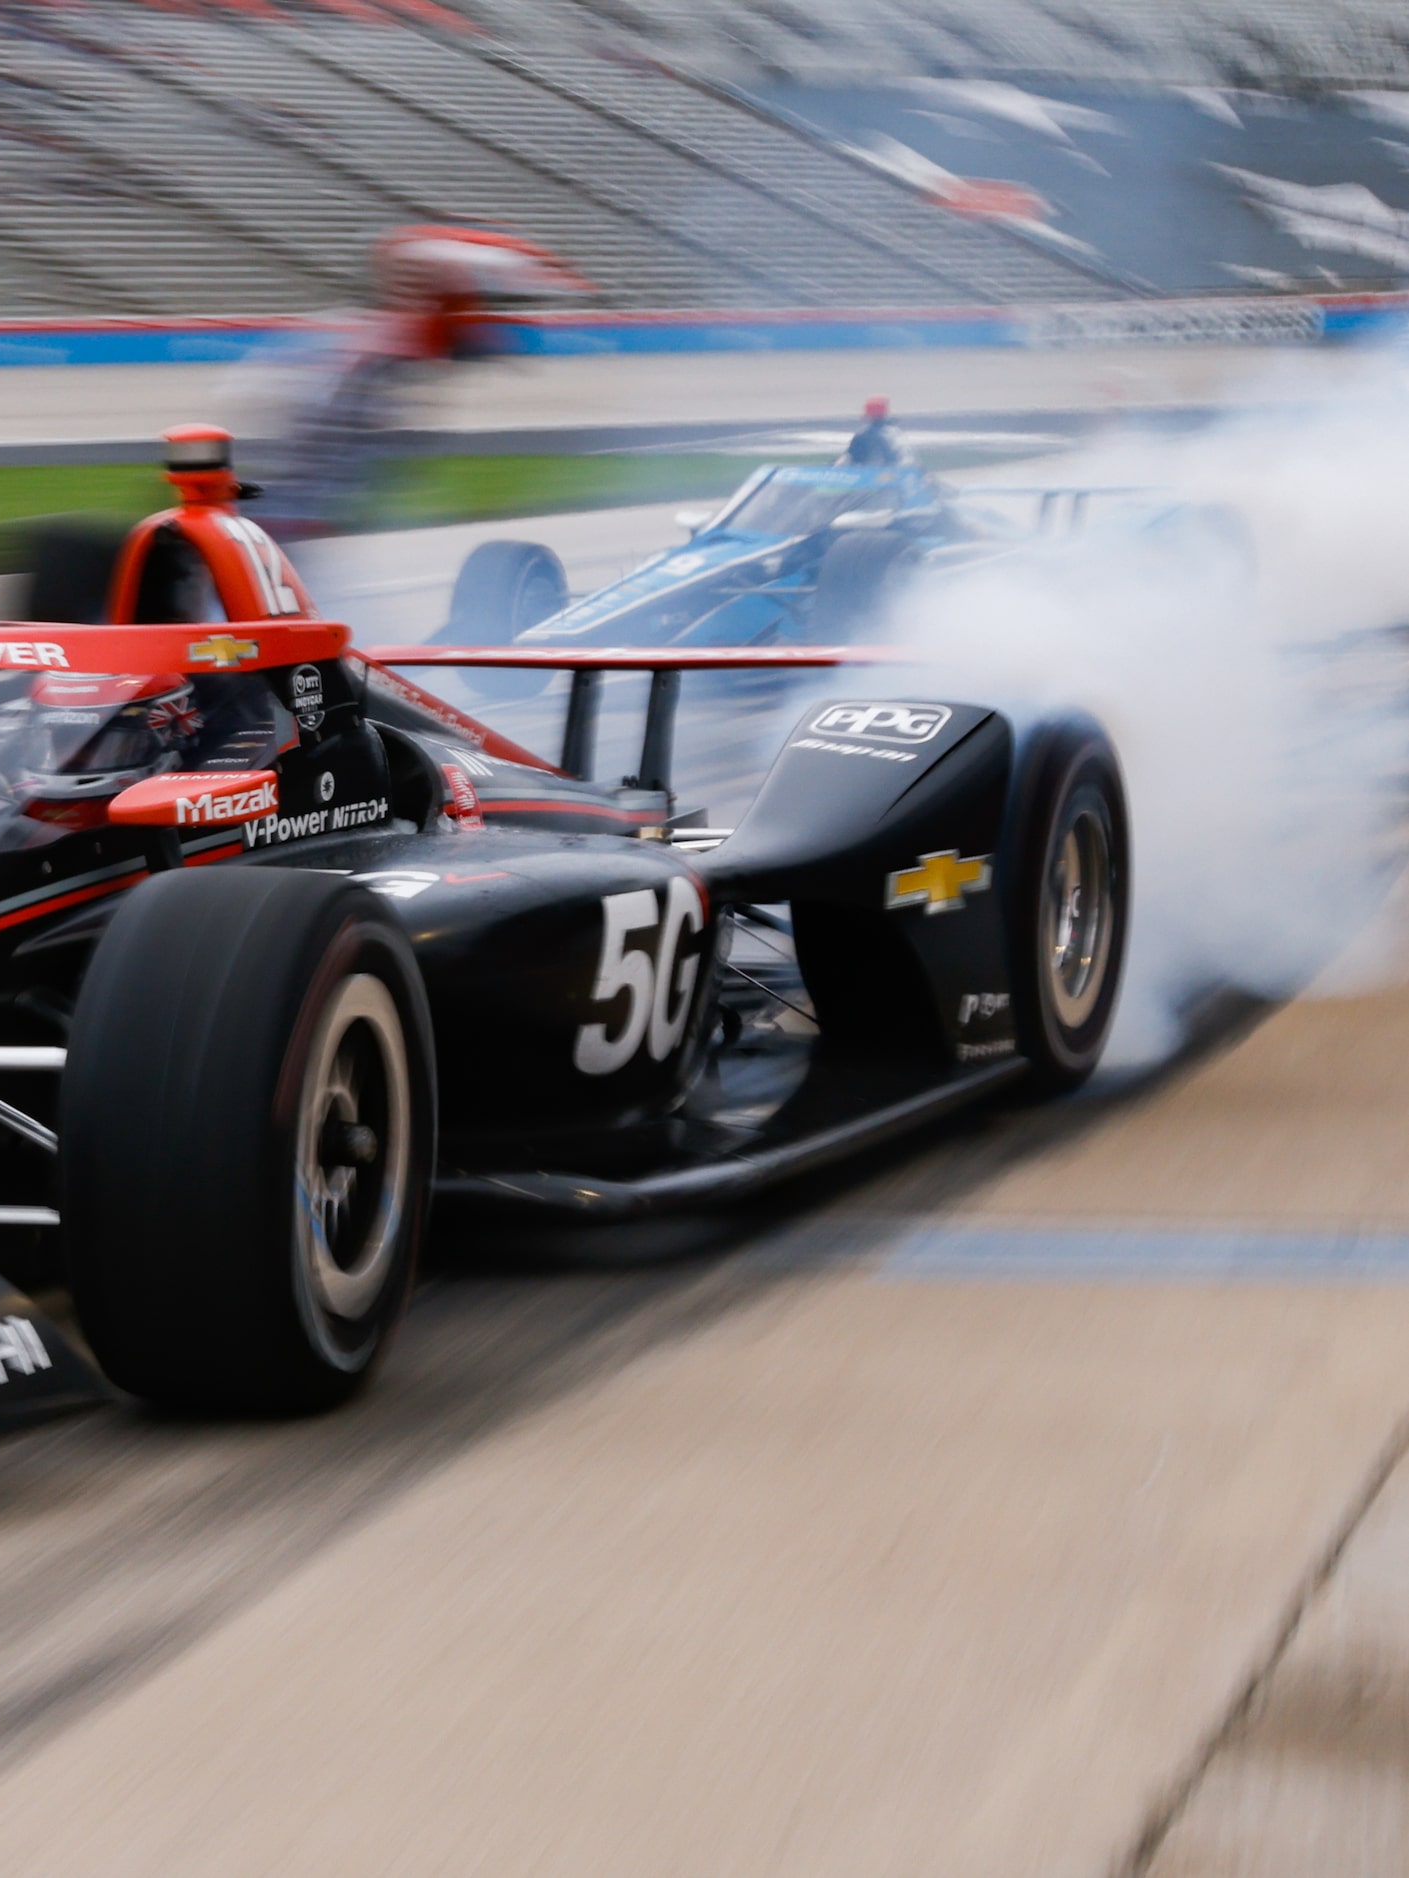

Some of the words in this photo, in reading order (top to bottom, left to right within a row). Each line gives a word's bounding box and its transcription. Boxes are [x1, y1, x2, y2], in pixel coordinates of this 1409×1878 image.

[214, 515, 301, 617] 12
[295, 694, 324, 708] INDYCAR
[818, 706, 941, 736] PPG
[159, 773, 252, 781] SIEMENS
[176, 781, 279, 824] Mazak
[245, 810, 328, 848] V-Power
[572, 876, 704, 1076] 5G
